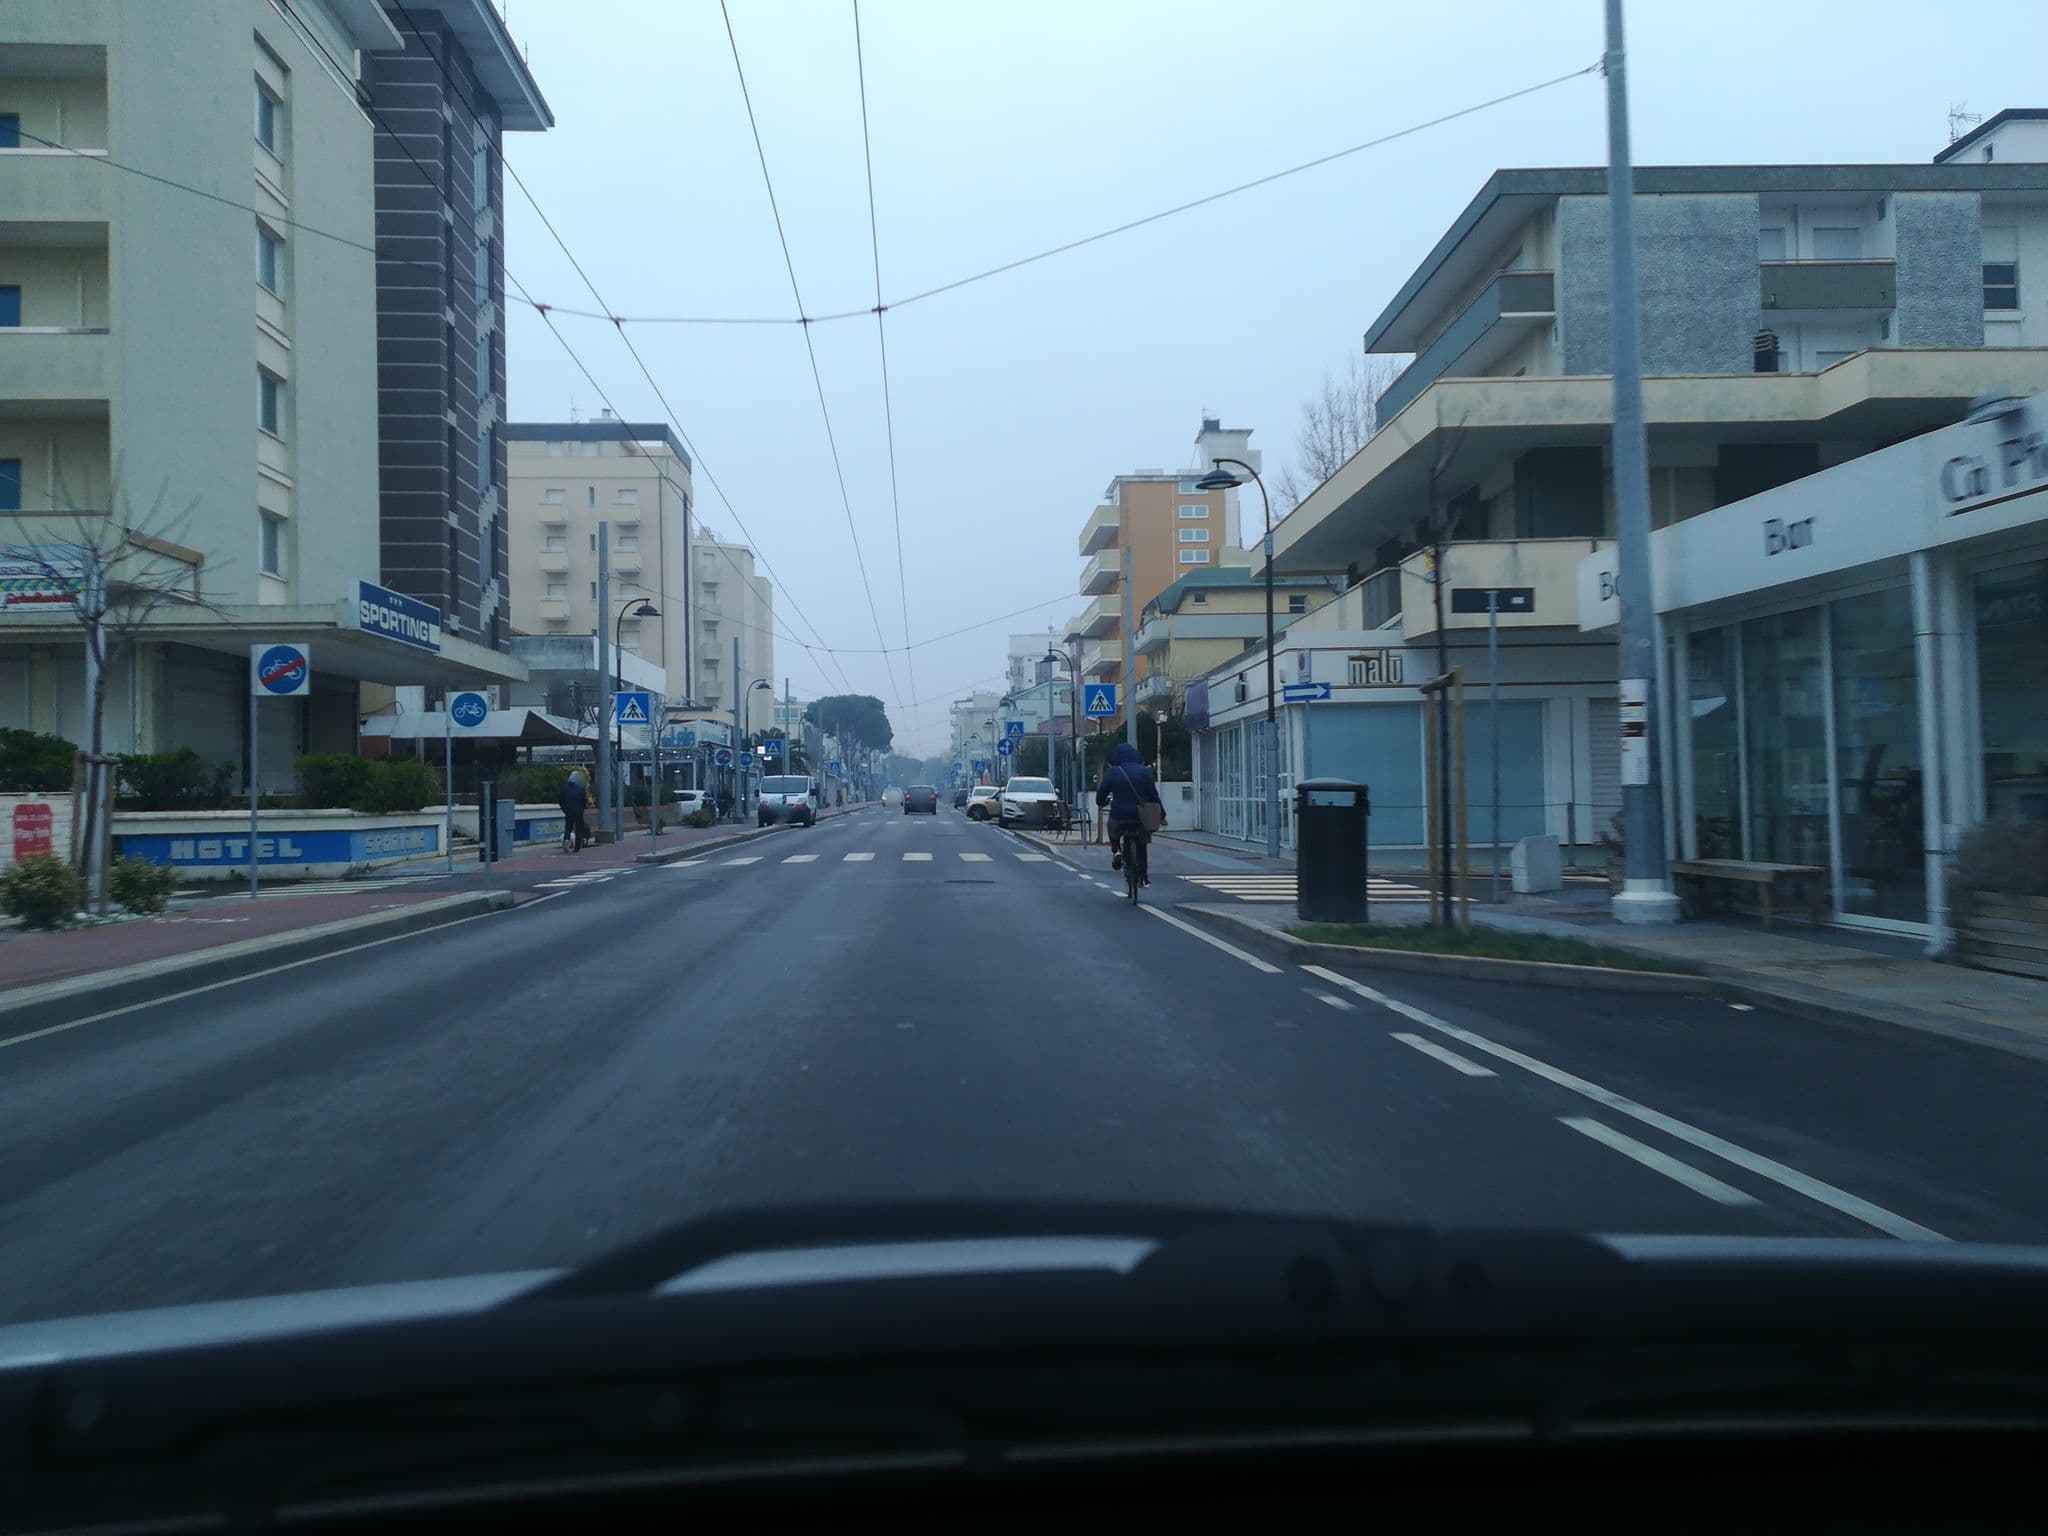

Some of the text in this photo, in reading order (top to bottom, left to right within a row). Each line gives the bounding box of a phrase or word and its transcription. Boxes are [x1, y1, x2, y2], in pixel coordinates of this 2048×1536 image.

[1762, 515, 1815, 557] Bar
[360, 599, 430, 642] SPORTING
[170, 837, 303, 860] HOTEL
